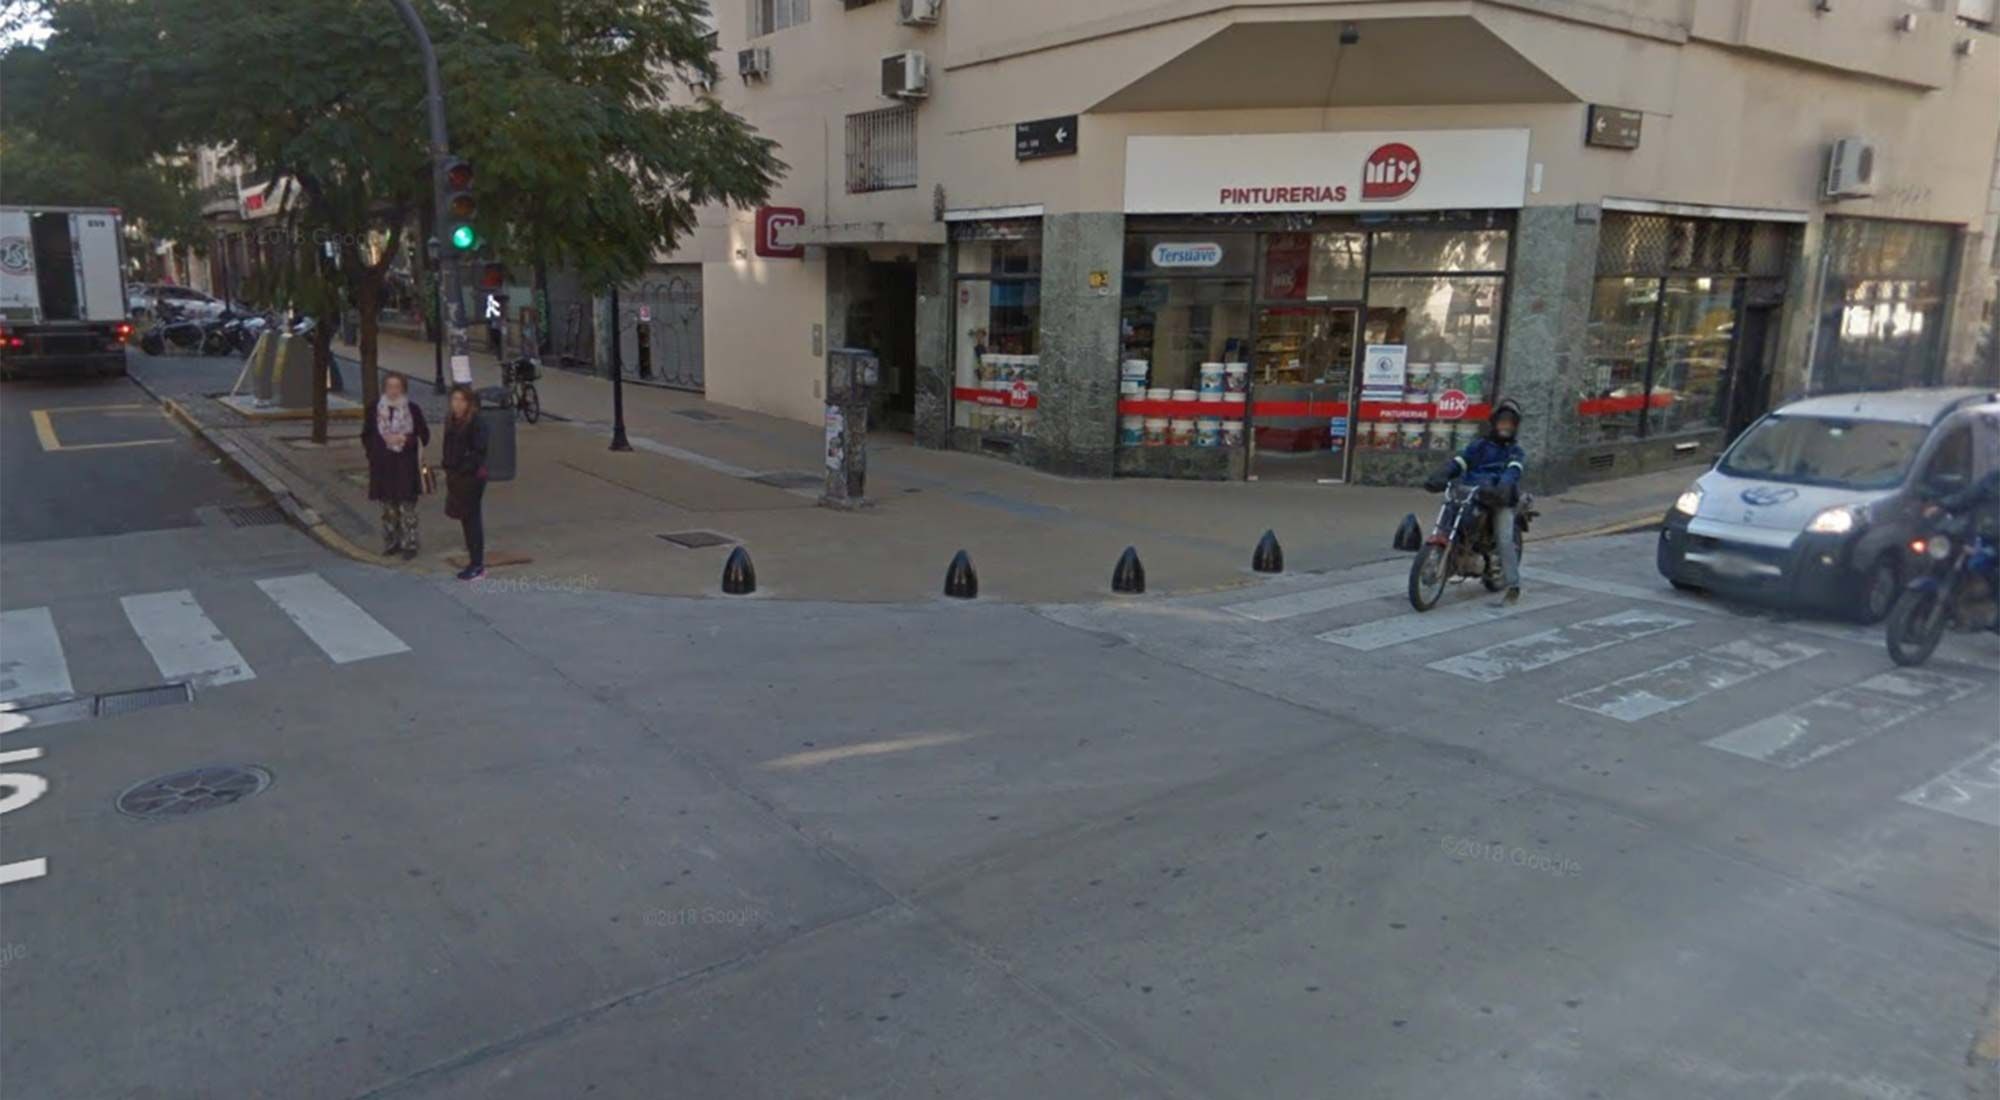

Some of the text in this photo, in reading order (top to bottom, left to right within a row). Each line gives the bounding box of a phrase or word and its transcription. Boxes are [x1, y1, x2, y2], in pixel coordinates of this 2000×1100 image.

[1219, 186, 1346, 204] PINTURERIAS
[1158, 247, 1217, 263] Tersuave
[1380, 409, 1429, 418] PINTURERIAS
